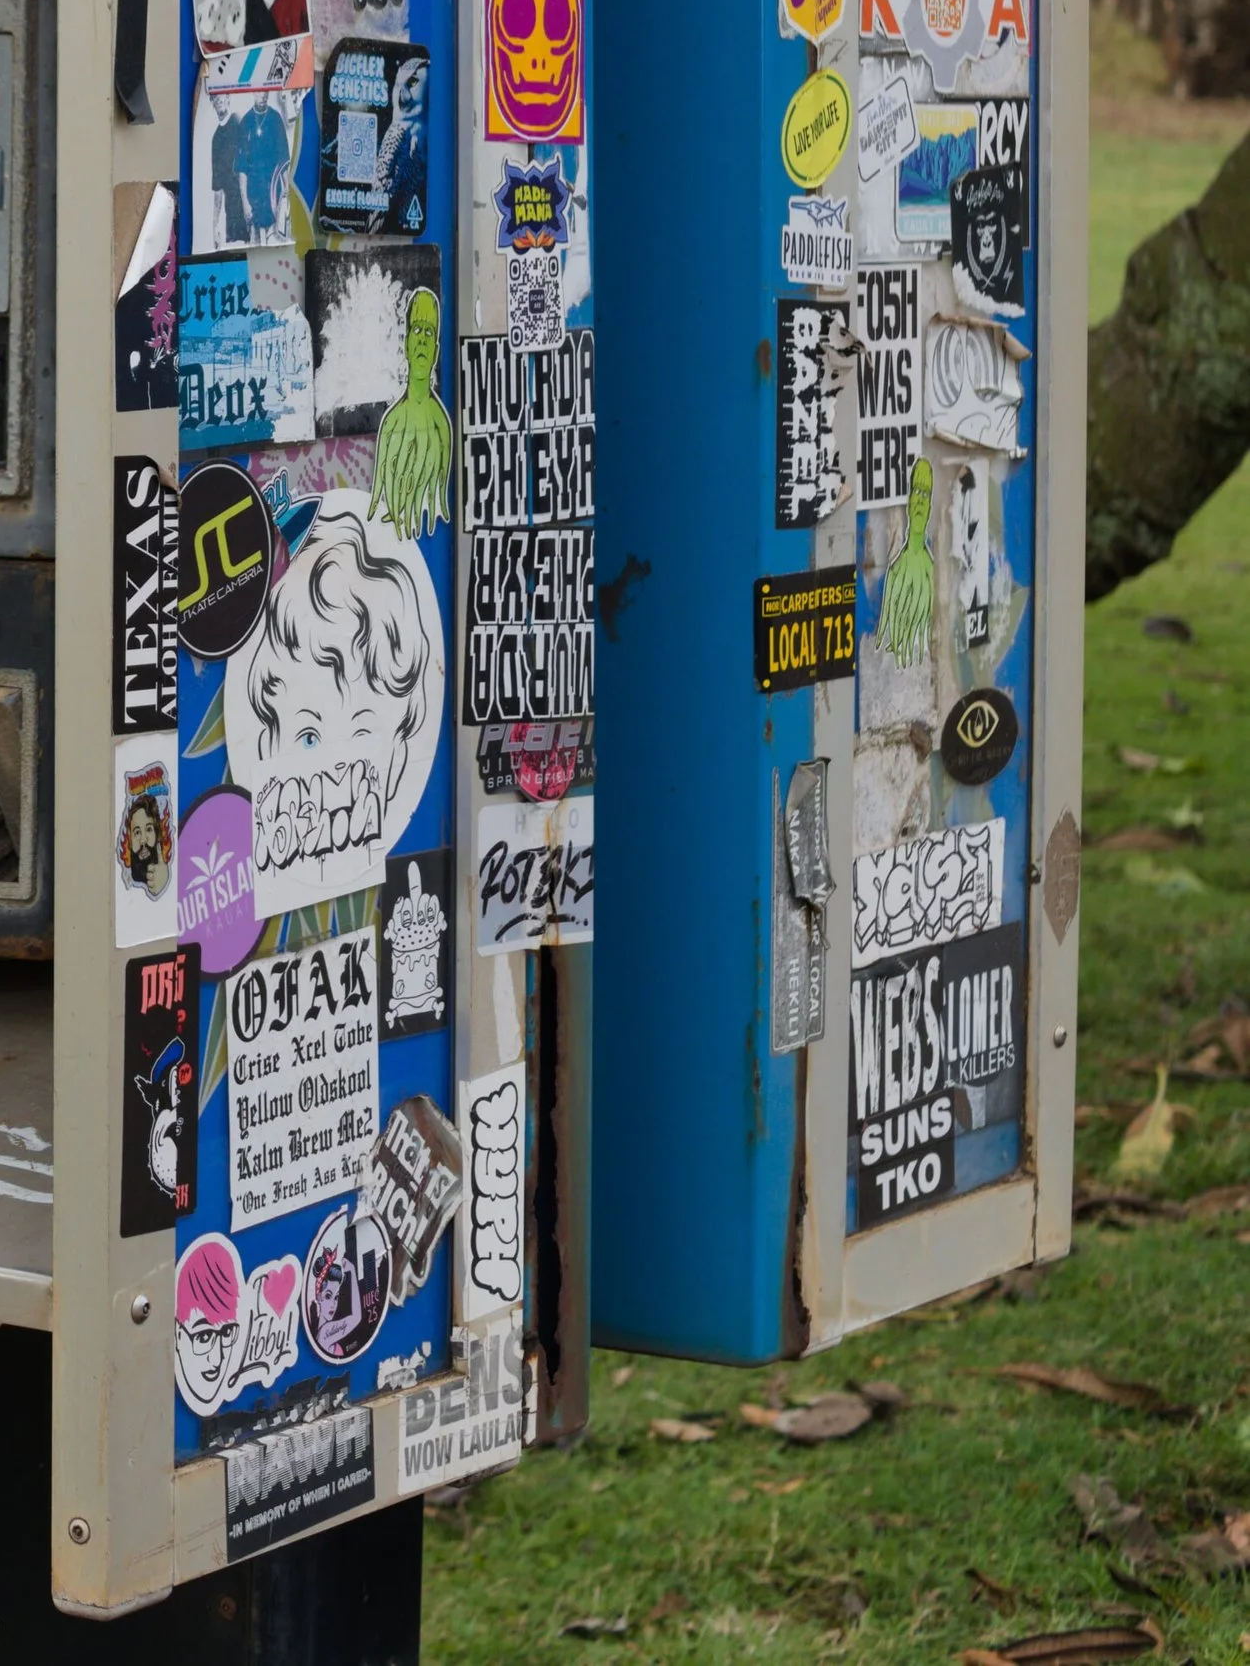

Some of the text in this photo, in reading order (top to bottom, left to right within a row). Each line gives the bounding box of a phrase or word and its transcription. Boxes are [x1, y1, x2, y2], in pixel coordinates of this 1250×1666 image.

[329, 75, 389, 107] GENETICS
[336, 53, 385, 78] BIGFLEX
[793, 122, 812, 157] LIVE
[824, 100, 840, 131] LIFE
[326, 189, 390, 211] EXOTIC FLOWER
[515, 185, 546, 203] MADE
[515, 203, 552, 225] MANA
[783, 233, 852, 271] PADDLEFISH
[858, 350, 912, 419] WAS
[124, 465, 161, 725] TEXAS
[181, 564, 264, 624] SKATE CAMBRIA
[161, 598, 178, 721] ALOHA
[769, 612, 854, 673] LOCAL 713
[487, 768, 575, 789] SPRINGFIELD
[231, 937, 373, 1043] OFAK
[787, 957, 801, 1038] HEKILI
[807, 952, 822, 1023] LOCAL
[233, 1052, 280, 1085] Crise
[291, 1030, 327, 1067] Xcel
[958, 1043, 1016, 1083] KILLERS
[236, 1059, 371, 1140] Yellow Oldskool
[237, 1143, 284, 1181] Kalm
[288, 1126, 333, 1162] Brew
[861, 1098, 952, 1165] SUNS
[313, 1164, 336, 1189] Ass
[876, 1150, 942, 1213] TKO
[367, 1309, 379, 1325] 25
[404, 1432, 455, 1478] WOW
[245, 1484, 331, 1534] MEMORY OF WHEN
